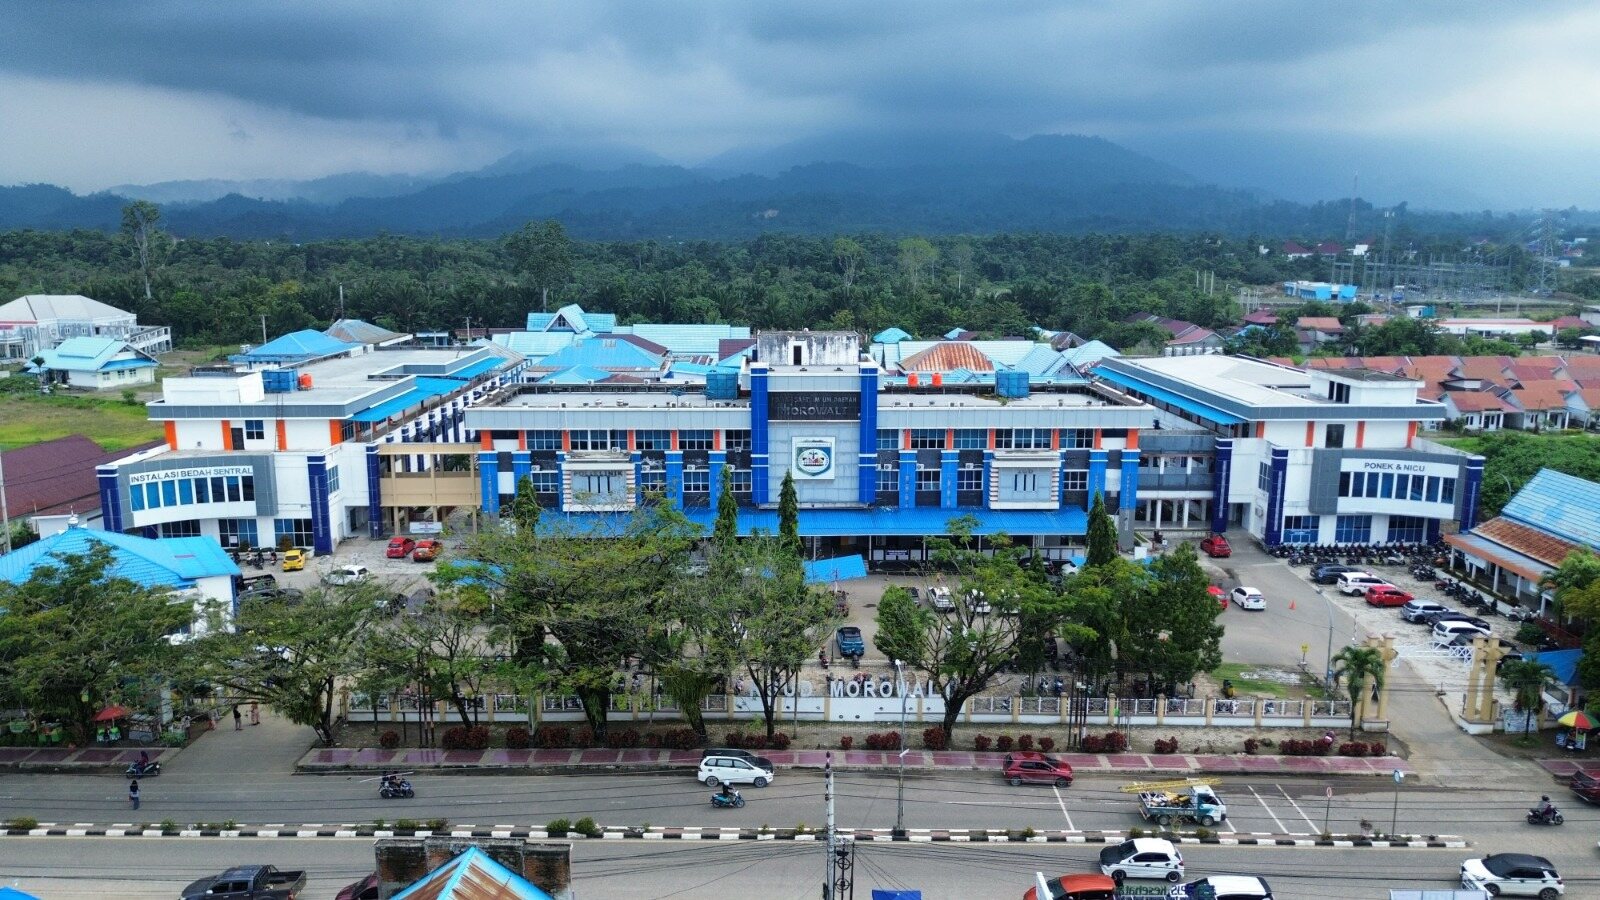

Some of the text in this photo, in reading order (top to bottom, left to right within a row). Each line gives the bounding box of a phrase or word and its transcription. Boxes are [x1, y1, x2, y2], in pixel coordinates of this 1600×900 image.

[1364, 462, 1426, 472] PONEK & NICU
[131, 467, 254, 483] INSTALASI BEDAH SENTRAL
